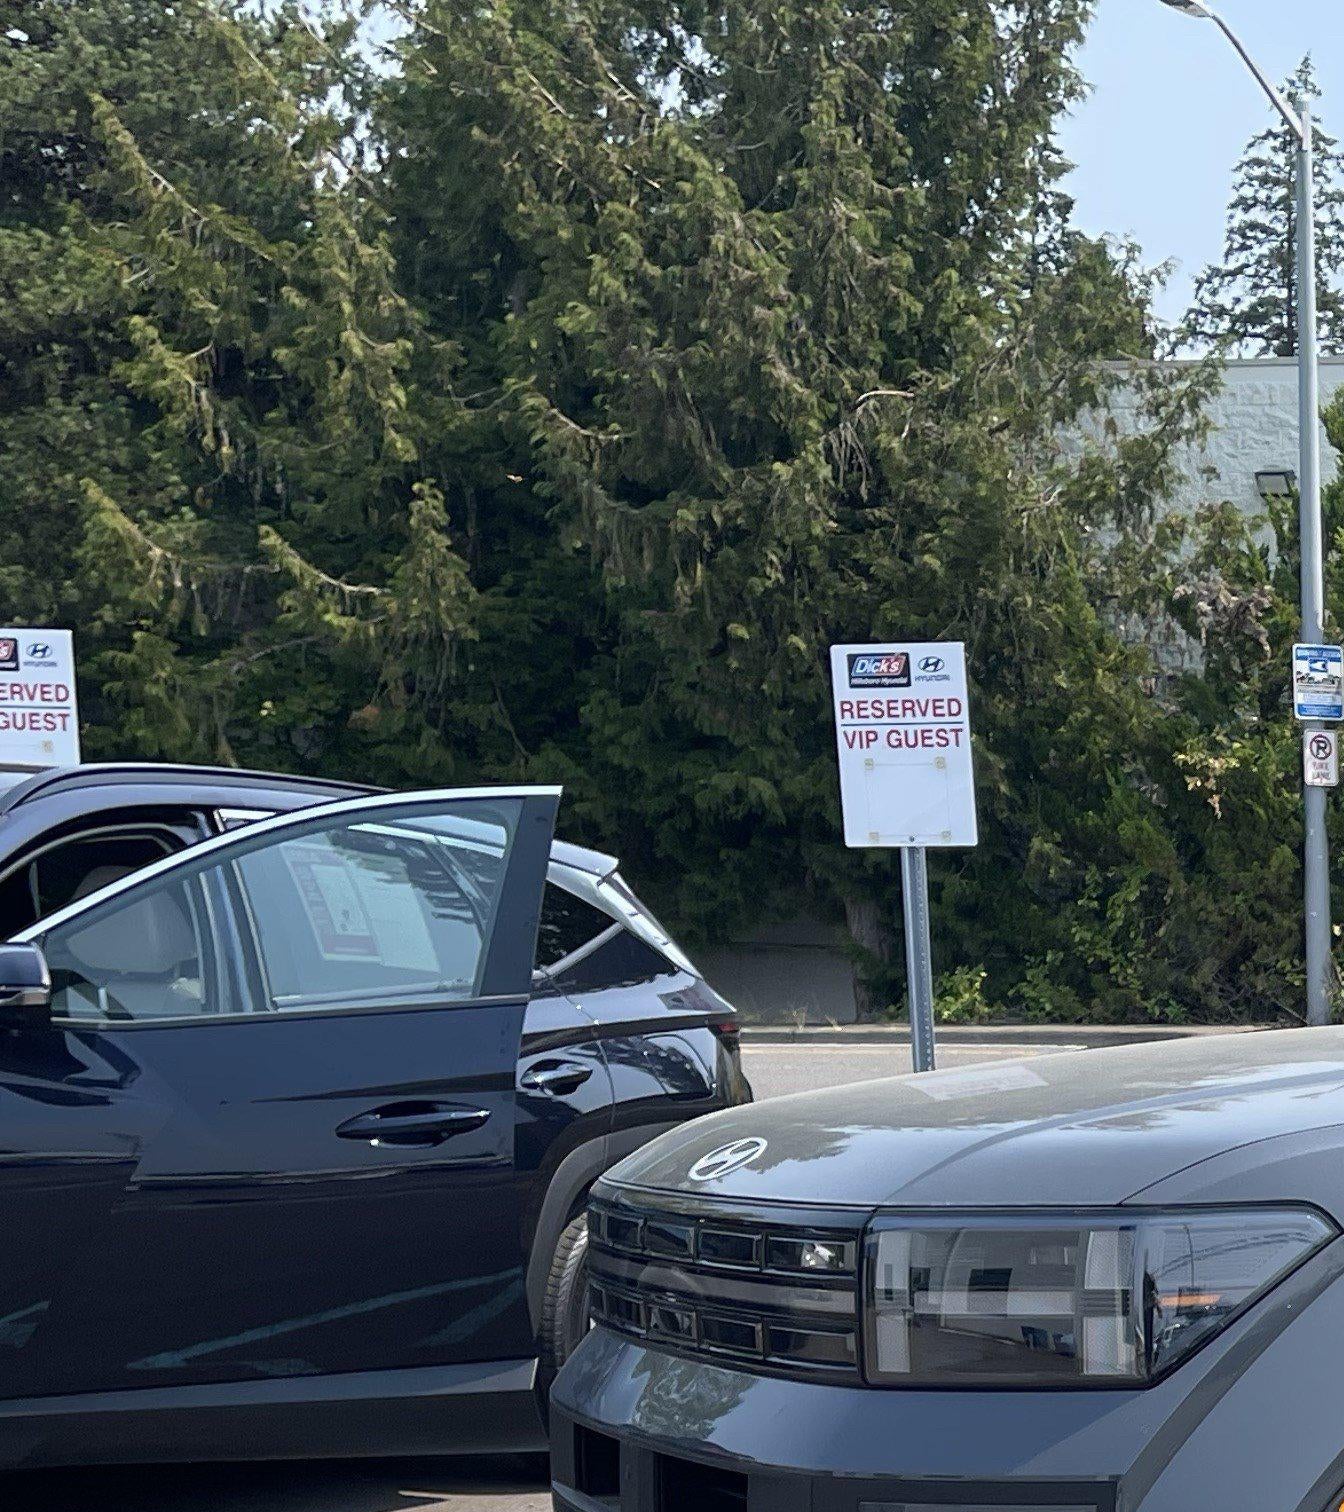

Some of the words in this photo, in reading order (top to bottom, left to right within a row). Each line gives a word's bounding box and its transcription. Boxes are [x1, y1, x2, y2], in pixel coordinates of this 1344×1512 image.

[840, 699, 962, 720] RESERVED
[0, 712, 70, 732] GUEST
[843, 730, 878, 750] VIP
[886, 728, 963, 749] GUEST
